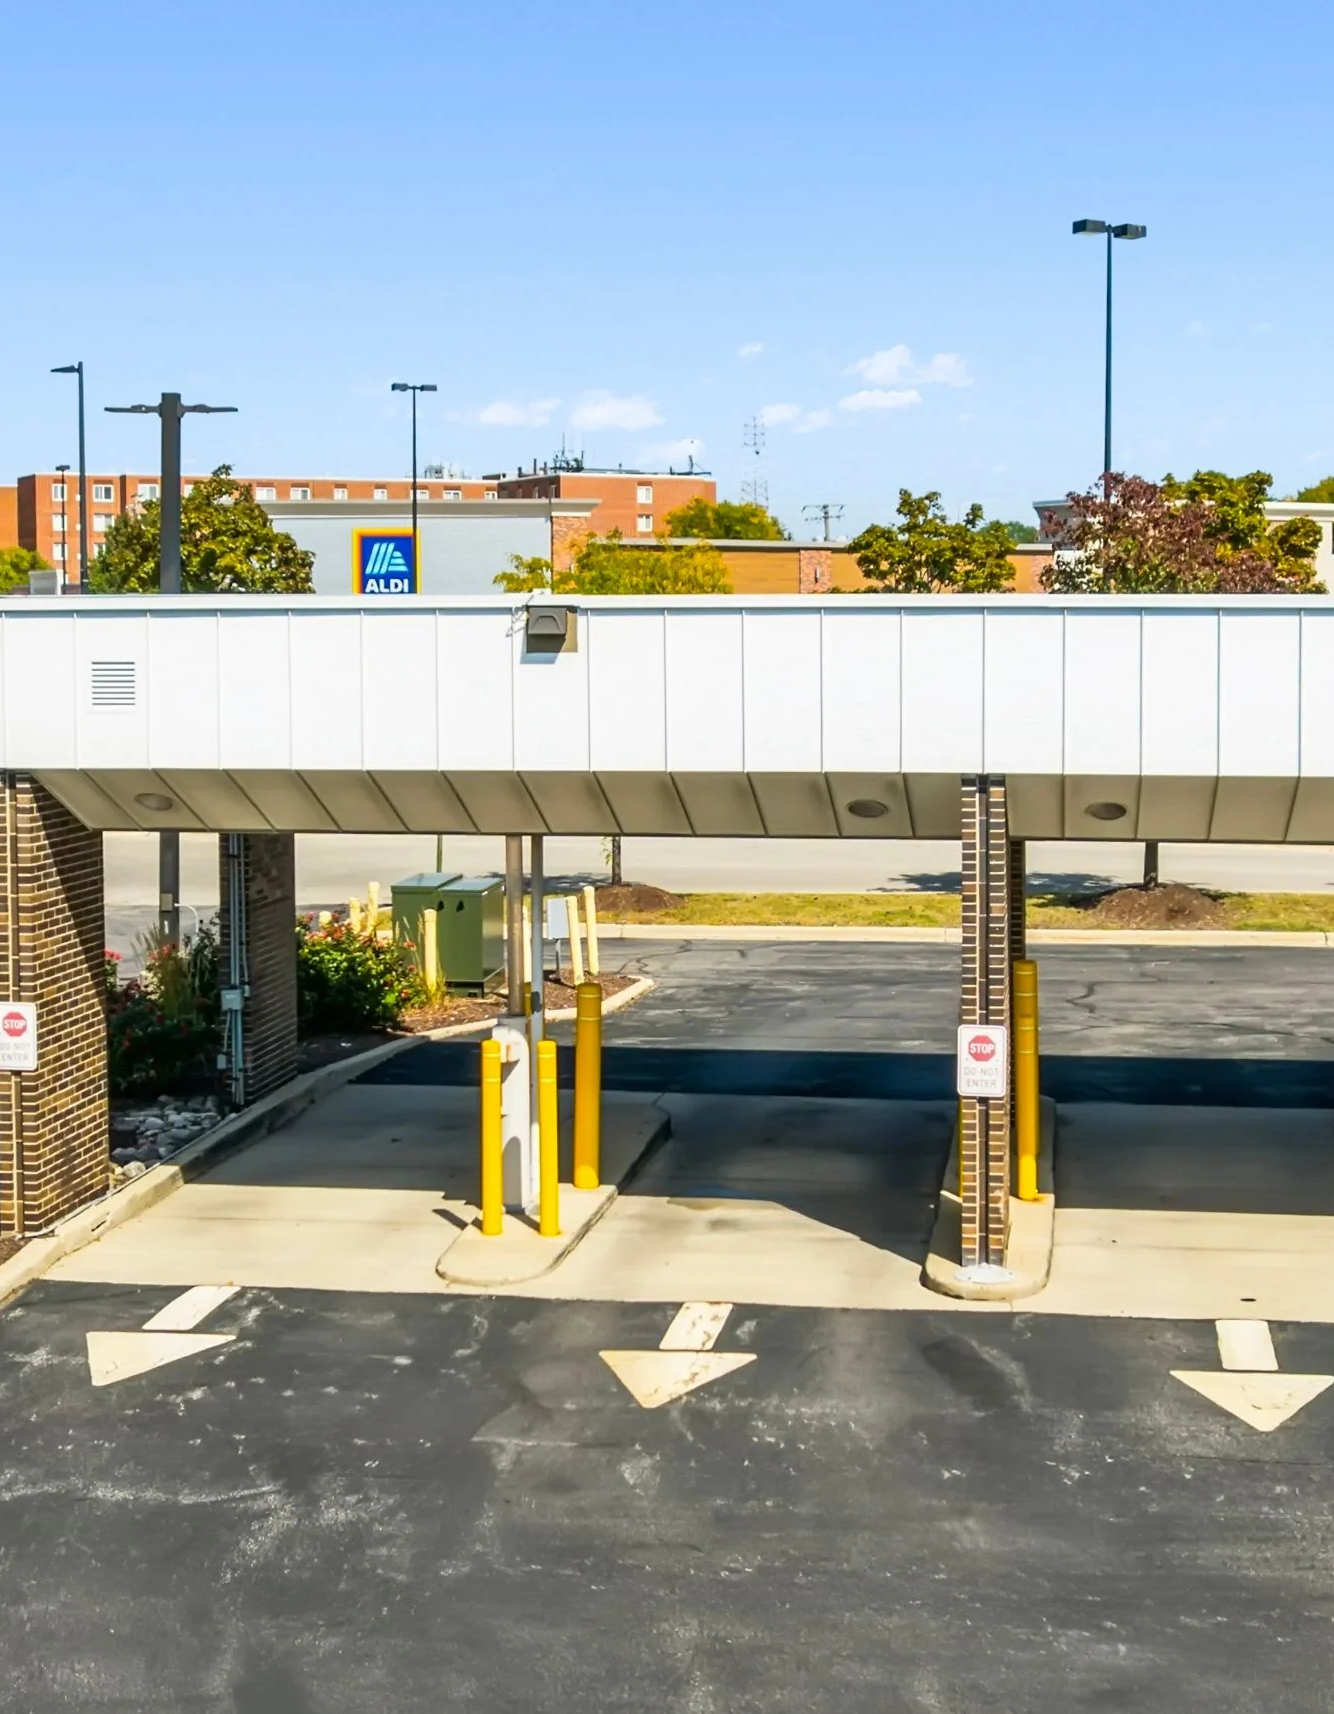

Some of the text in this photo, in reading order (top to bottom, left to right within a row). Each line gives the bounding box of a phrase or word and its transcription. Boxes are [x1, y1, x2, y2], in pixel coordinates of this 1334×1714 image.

[365, 578, 409, 593] ALDI
[3, 1018, 27, 1030] STOP
[969, 1042, 995, 1054] STOP
[980, 1066, 999, 1077] NOT
[966, 1078, 997, 1089] ENTER
